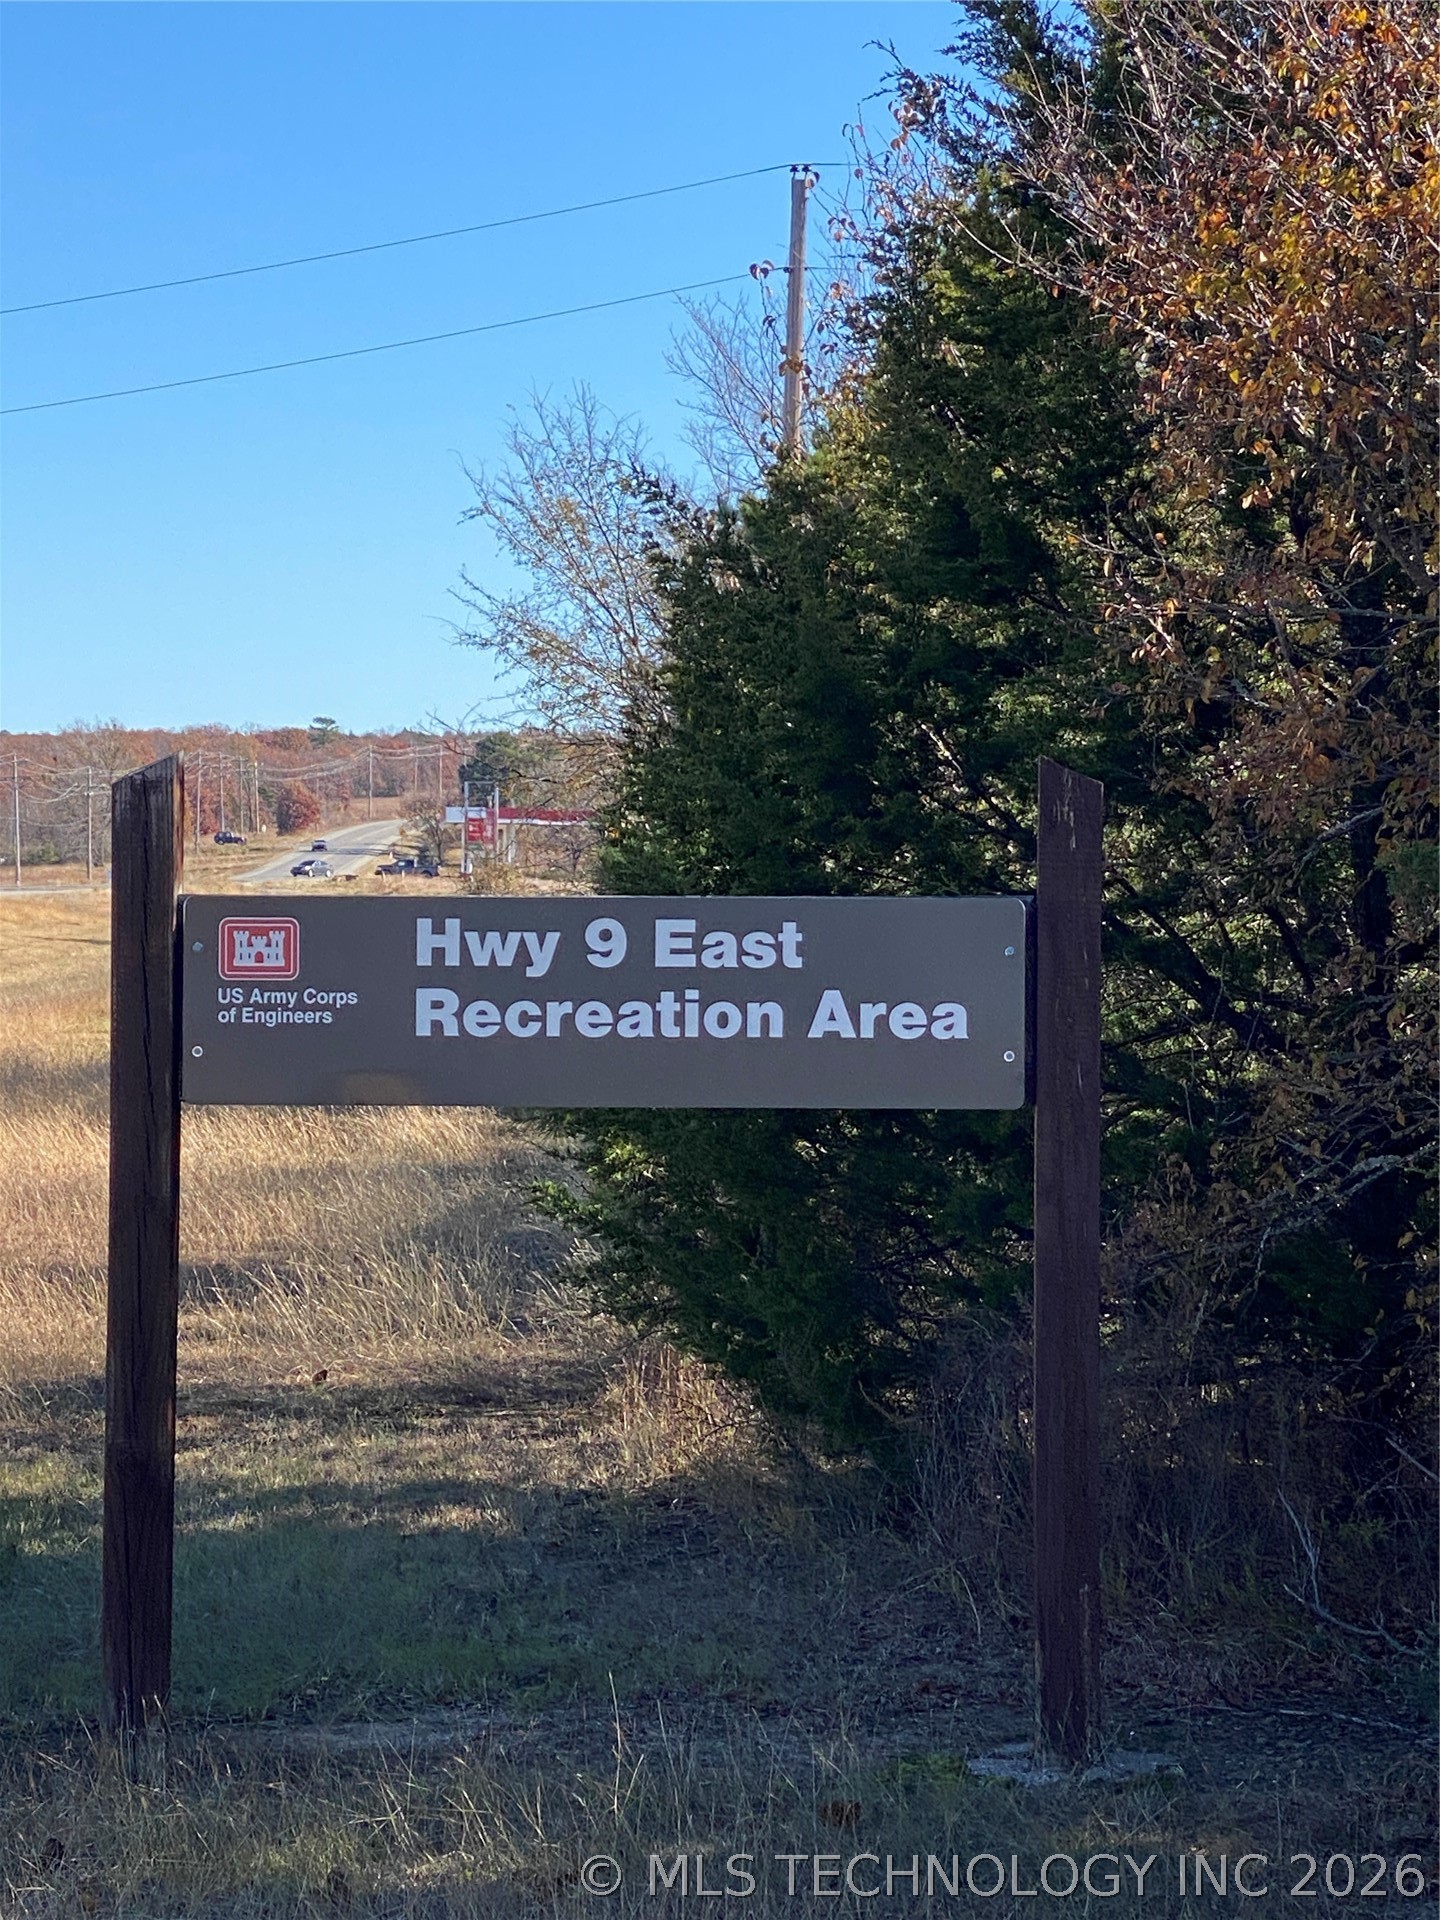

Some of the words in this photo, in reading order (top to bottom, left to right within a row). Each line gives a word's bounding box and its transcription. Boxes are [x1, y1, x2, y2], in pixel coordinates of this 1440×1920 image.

[416, 918, 560, 978] Hwy
[585, 917, 627, 968] 9
[654, 919, 803, 969] East
[218, 988, 243, 1004] US
[249, 988, 297, 1008] Army
[303, 988, 358, 1008] Corps
[415, 988, 784, 1039] Recreation
[808, 989, 969, 1040] Area
[217, 1007, 237, 1023] of
[241, 1008, 333, 1027] Engineers
